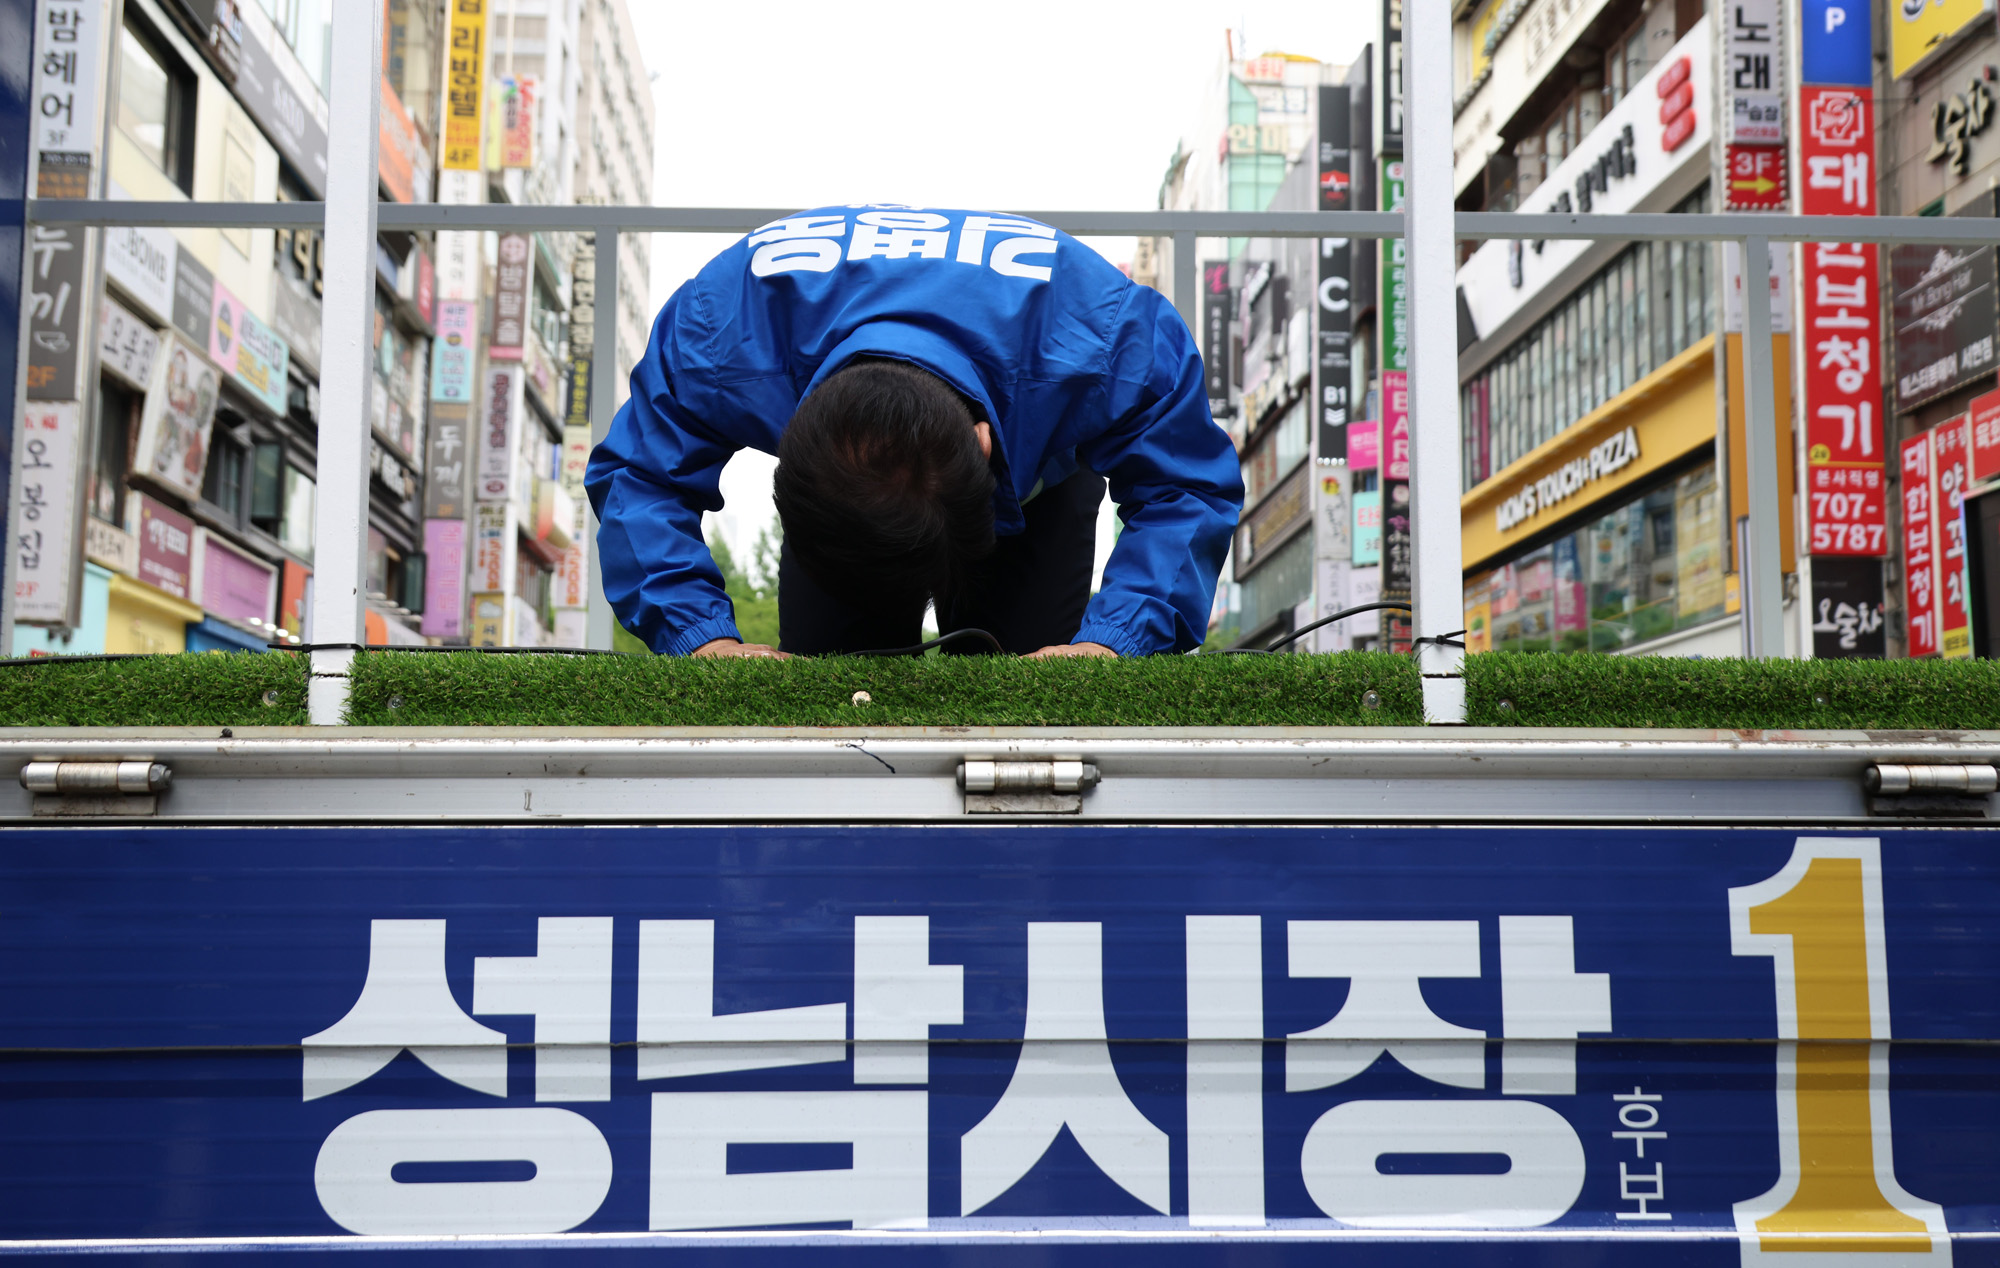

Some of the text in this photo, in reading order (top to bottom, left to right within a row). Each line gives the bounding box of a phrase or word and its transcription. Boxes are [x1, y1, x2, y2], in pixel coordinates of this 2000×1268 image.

[1825, 7, 1846, 34] P
[41, 0, 84, 127] 밤헤어
[1733, 6, 1771, 90] 노래
[1734, 98, 1778, 122] 연습장
[1735, 152, 1772, 176] 3F
[1960, 334, 1993, 370] 서현점
[27, 365, 57, 388] 2F
[1324, 386, 1347, 404] B1
[1497, 484, 1537, 532] MOM'S
[1535, 457, 1587, 507] TOUCH
[1590, 426, 1640, 482] PIZZA
[1815, 469, 1879, 488] 본사직영
[17, 438, 52, 570] 오봉집
[1812, 493, 1877, 519] 707-
[1813, 524, 1884, 550] 5787
[1903, 438, 1934, 648] 대한보청기
[1812, 598, 1883, 649] 오술차
[1728, 837, 1952, 1268] 1
[302, 915, 1612, 1236] 성남시장
[1612, 1087, 1672, 1221] 후보
